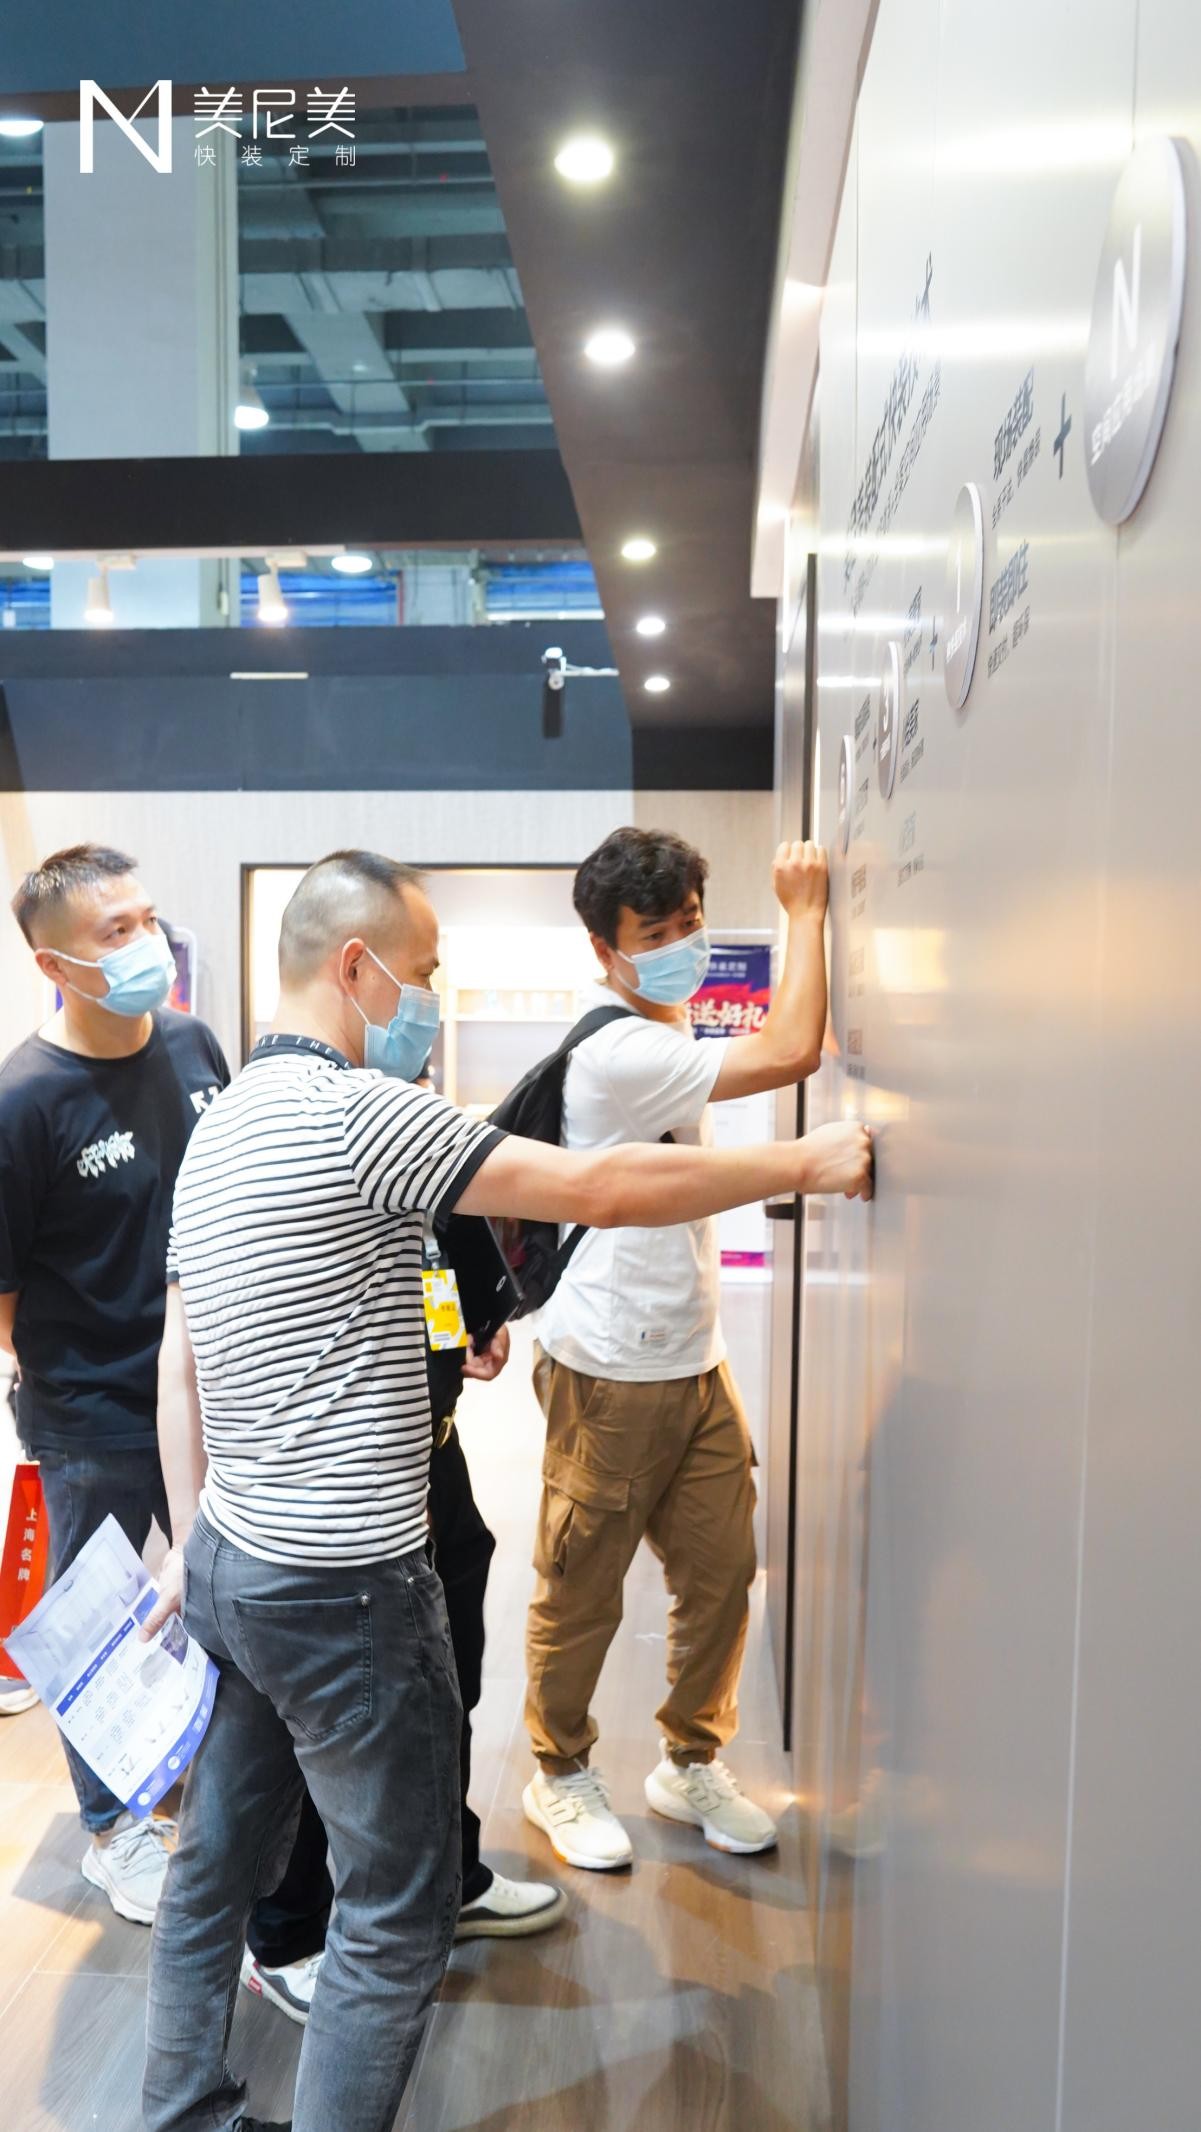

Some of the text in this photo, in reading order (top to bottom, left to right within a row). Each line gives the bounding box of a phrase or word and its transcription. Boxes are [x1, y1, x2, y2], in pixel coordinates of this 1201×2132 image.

[1111, 222, 1142, 381] N
[17, 1507, 38, 1582] 上海名牌
